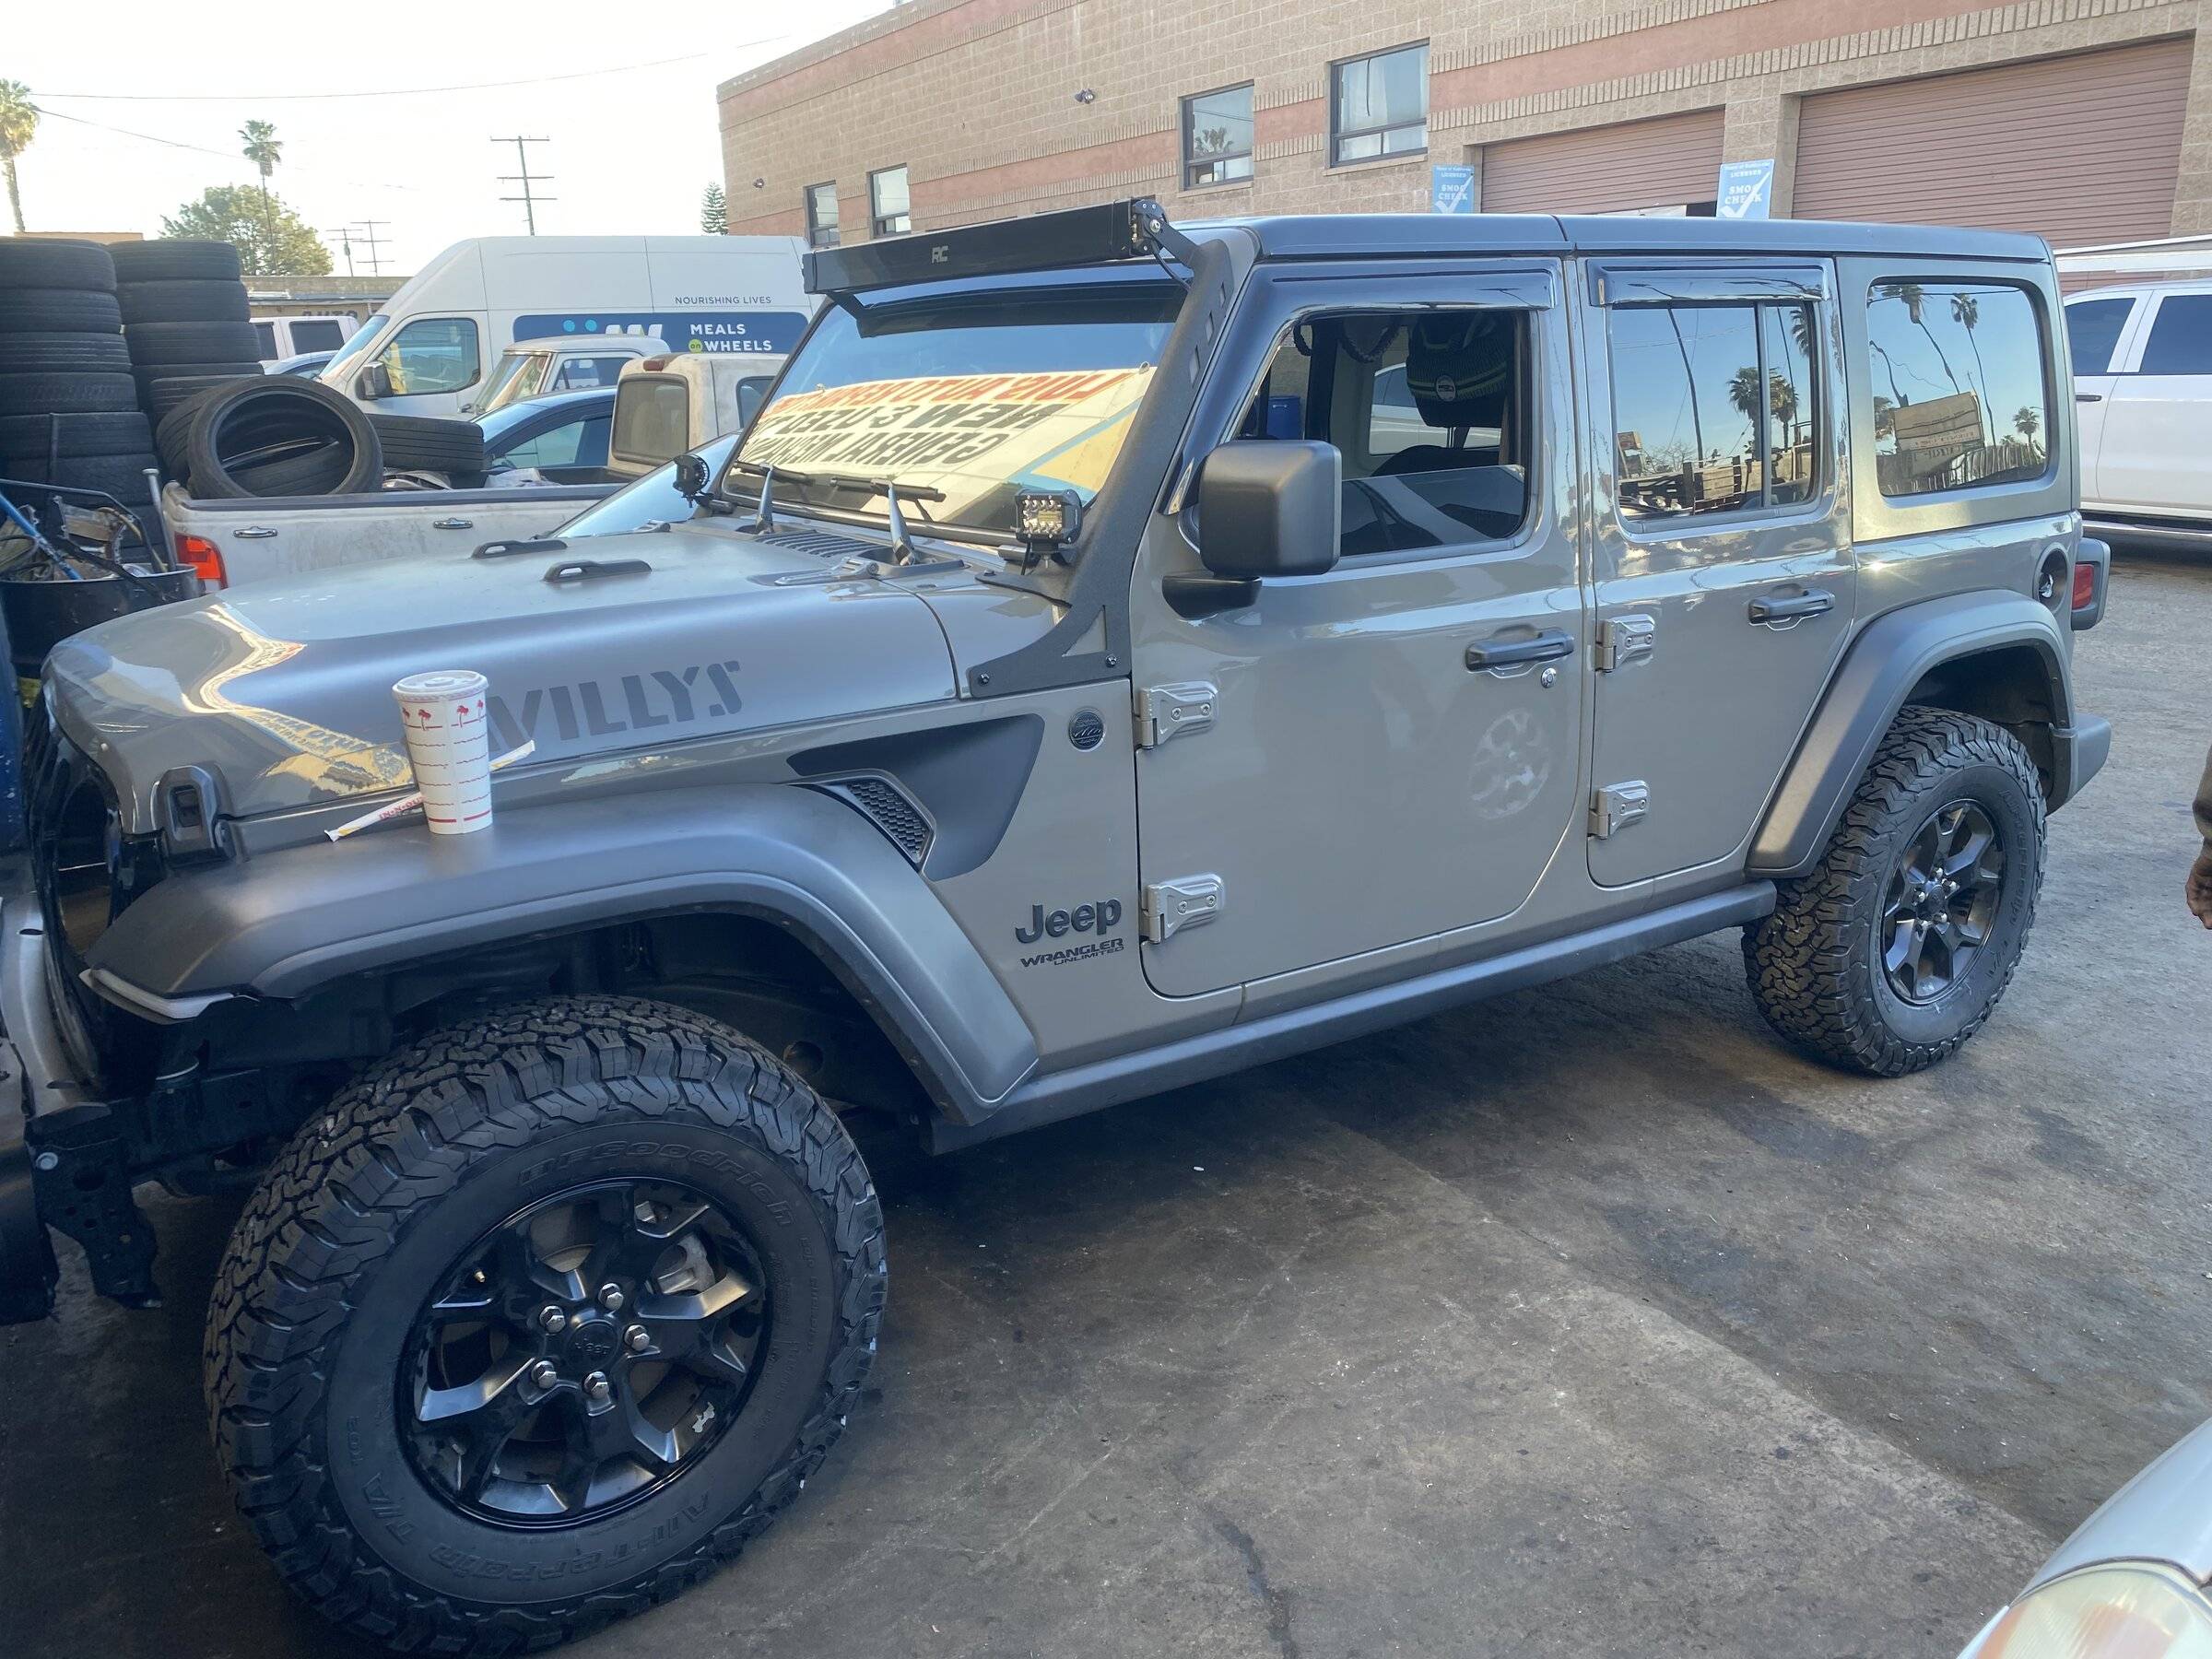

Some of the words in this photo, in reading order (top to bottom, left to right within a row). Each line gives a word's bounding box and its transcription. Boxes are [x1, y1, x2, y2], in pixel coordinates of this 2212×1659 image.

[1725, 194, 1762, 204] CHEK
[932, 246, 948, 264] RC
[675, 296, 740, 304] NOURISHING
[743, 296, 771, 304] LIVES
[689, 324, 746, 335] MEALS
[704, 340, 772, 351] WHEELS
[1015, 899, 1122, 944] Jeep
[1019, 938, 1124, 968] WRANGLER
[1053, 947, 1124, 966] UNLIMITED
